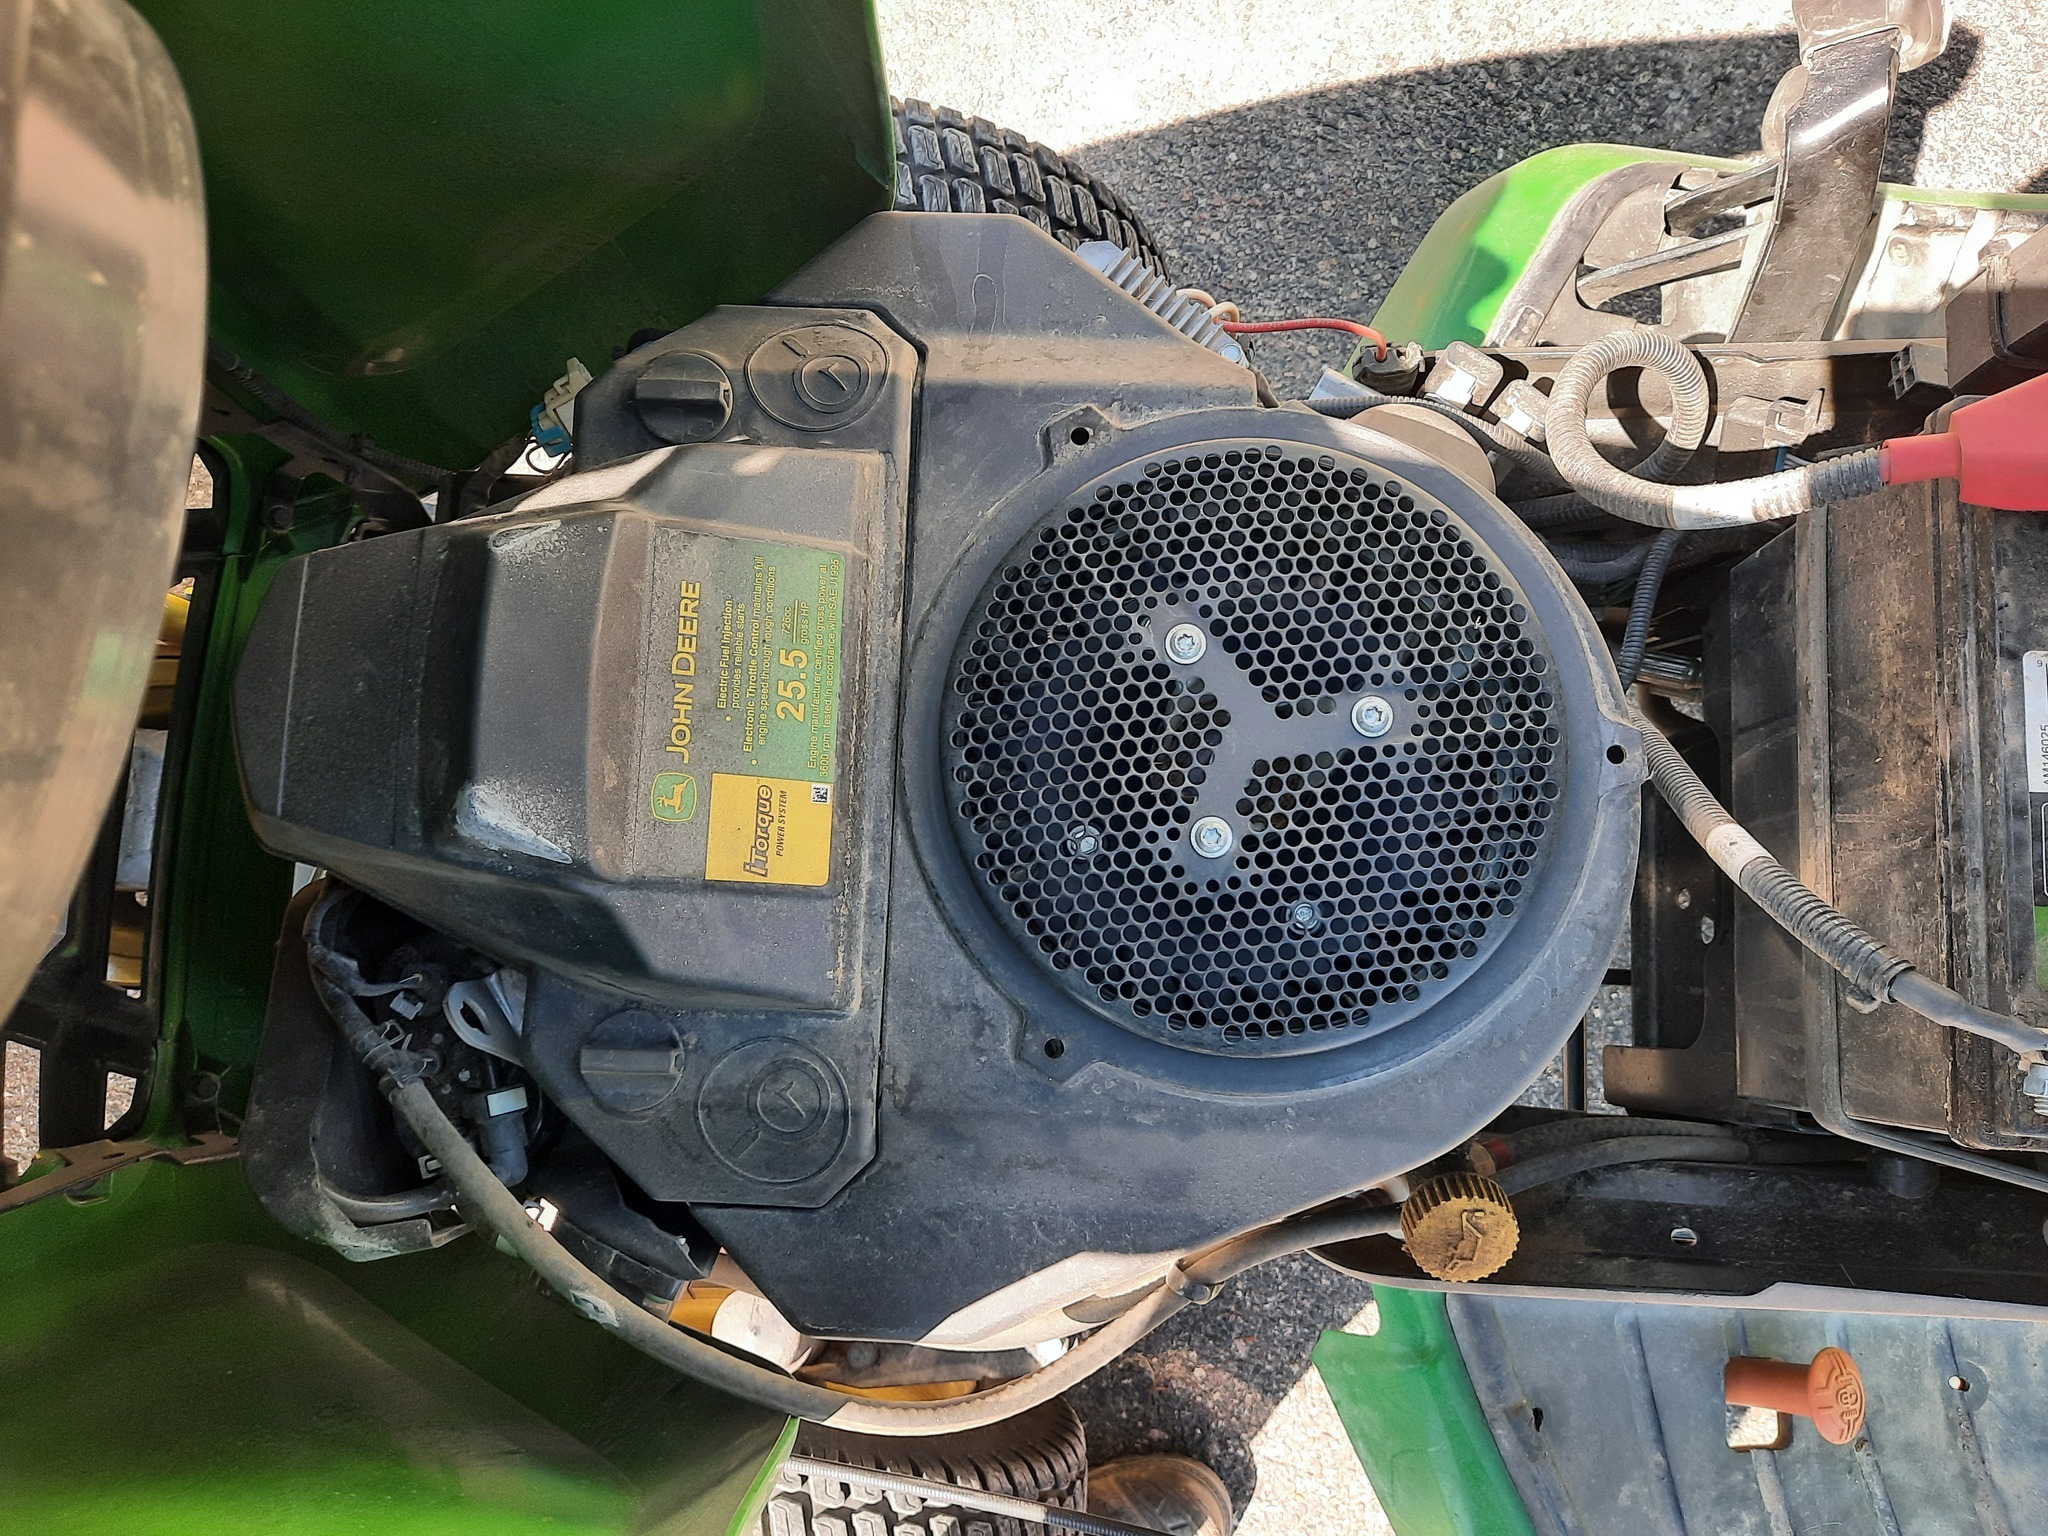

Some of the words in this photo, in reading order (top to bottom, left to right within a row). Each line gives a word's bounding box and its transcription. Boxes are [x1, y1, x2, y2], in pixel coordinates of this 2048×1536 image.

[754, 556, 765, 570] full
[819, 564, 826, 574] at
[830, 558, 840, 587] J1995
[752, 572, 763, 617] maintains
[765, 566, 776, 613] conditions
[818, 576, 827, 604] power
[828, 589, 838, 610] SAE
[721, 600, 733, 643] Injection
[736, 602, 745, 629] starts
[781, 606, 792, 635] 726cc
[800, 601, 809, 616] HP
[815, 606, 826, 632] gross
[827, 612, 836, 630] with
[671, 580, 701, 676] DEERE
[748, 619, 760, 656] Control
[800, 619, 809, 645] gross
[720, 645, 730, 668] Fuel
[733, 632, 743, 666] reliable
[761, 644, 773, 680] through
[813, 634, 824, 670] certified
[826, 634, 835, 686] accordance
[716, 670, 729, 709] Electric
[731, 668, 742, 709] provides
[746, 659, 758, 698] Throttle
[775, 648, 808, 722] 25.5
[823, 688, 832, 697] in
[760, 682, 770, 711] speed
[809, 672, 821, 734] manufacturer
[666, 682, 694, 763] JOHN
[743, 701, 755, 752] Electronic
[757, 714, 768, 746] engine
[822, 700, 832, 728] tested
[808, 736, 818, 768] Engine
[819, 754, 829, 778] 3600
[777, 790, 787, 824] SYSTEM
[775, 827, 785, 857] POWER
